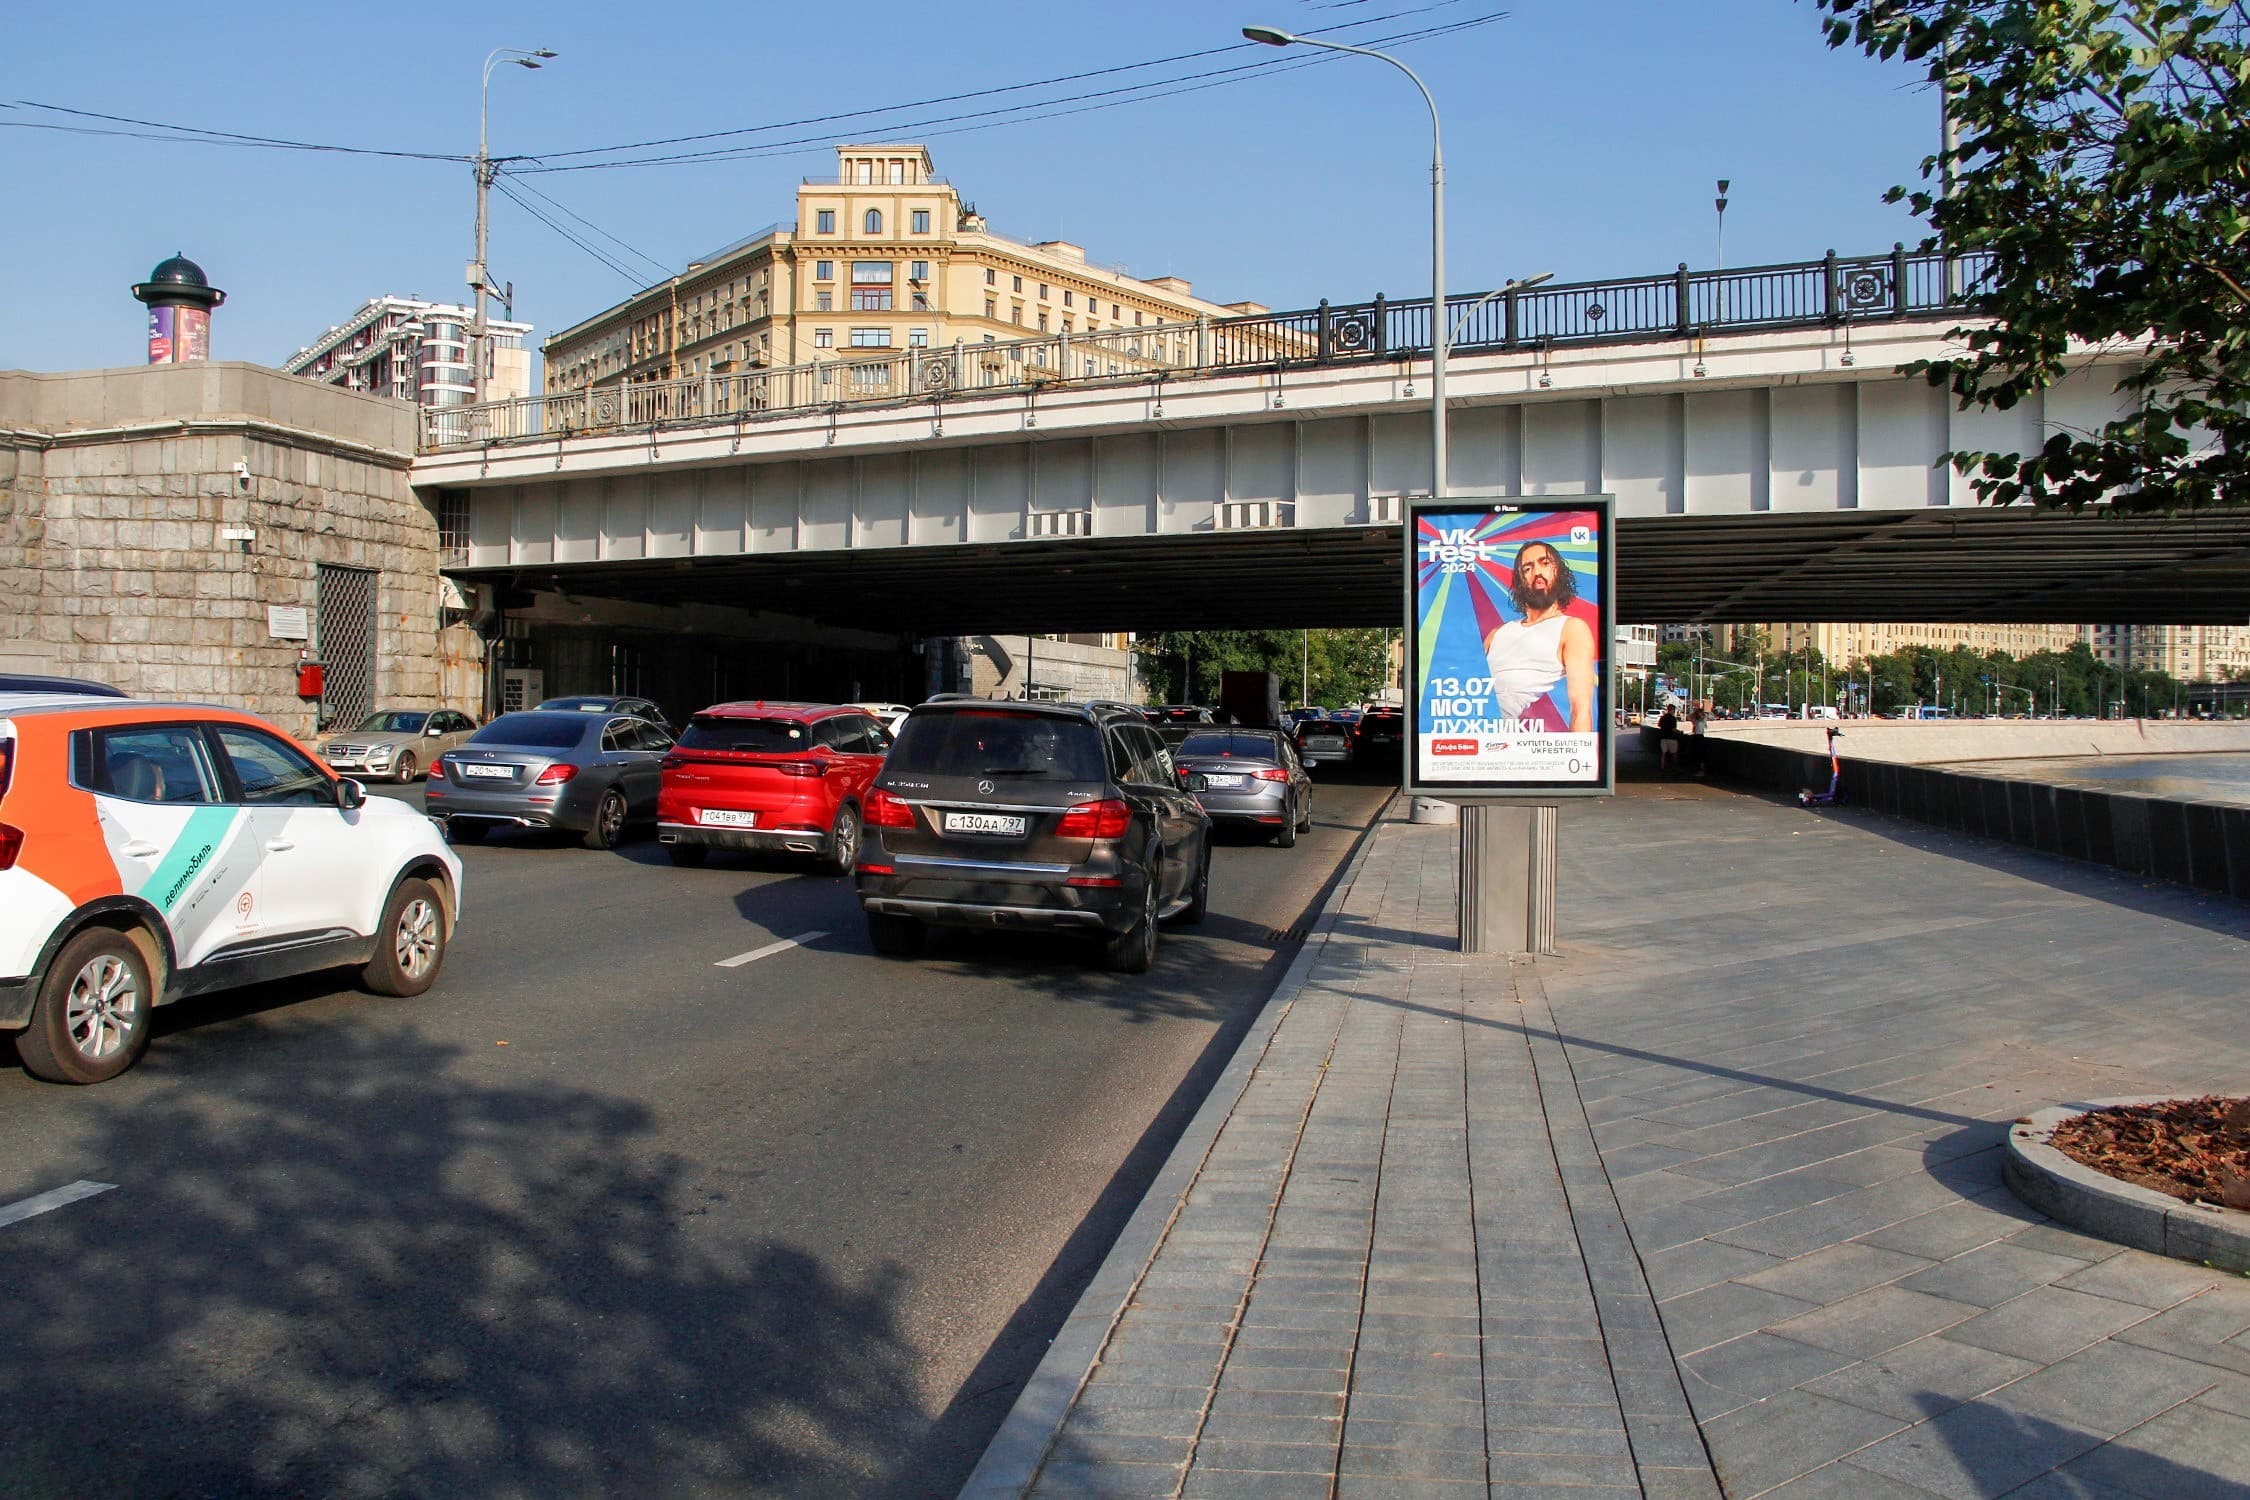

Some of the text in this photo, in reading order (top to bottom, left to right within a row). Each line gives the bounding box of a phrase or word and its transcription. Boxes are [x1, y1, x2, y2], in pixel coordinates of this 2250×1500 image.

[1439, 529, 1476, 545] VK
[1574, 532, 1586, 540] VK
[1429, 540, 1496, 562] fest
[1441, 563, 1476, 573] 2024
[1431, 678, 1496, 696] 13.07
[1431, 698, 1488, 716] МОТ
[1431, 718, 1544, 733] ЛУЖНИКИ
[1568, 759, 1592, 774] 0+
[950, 816, 1022, 830] С130АА 797
[165, 844, 212, 908] делимобиль
